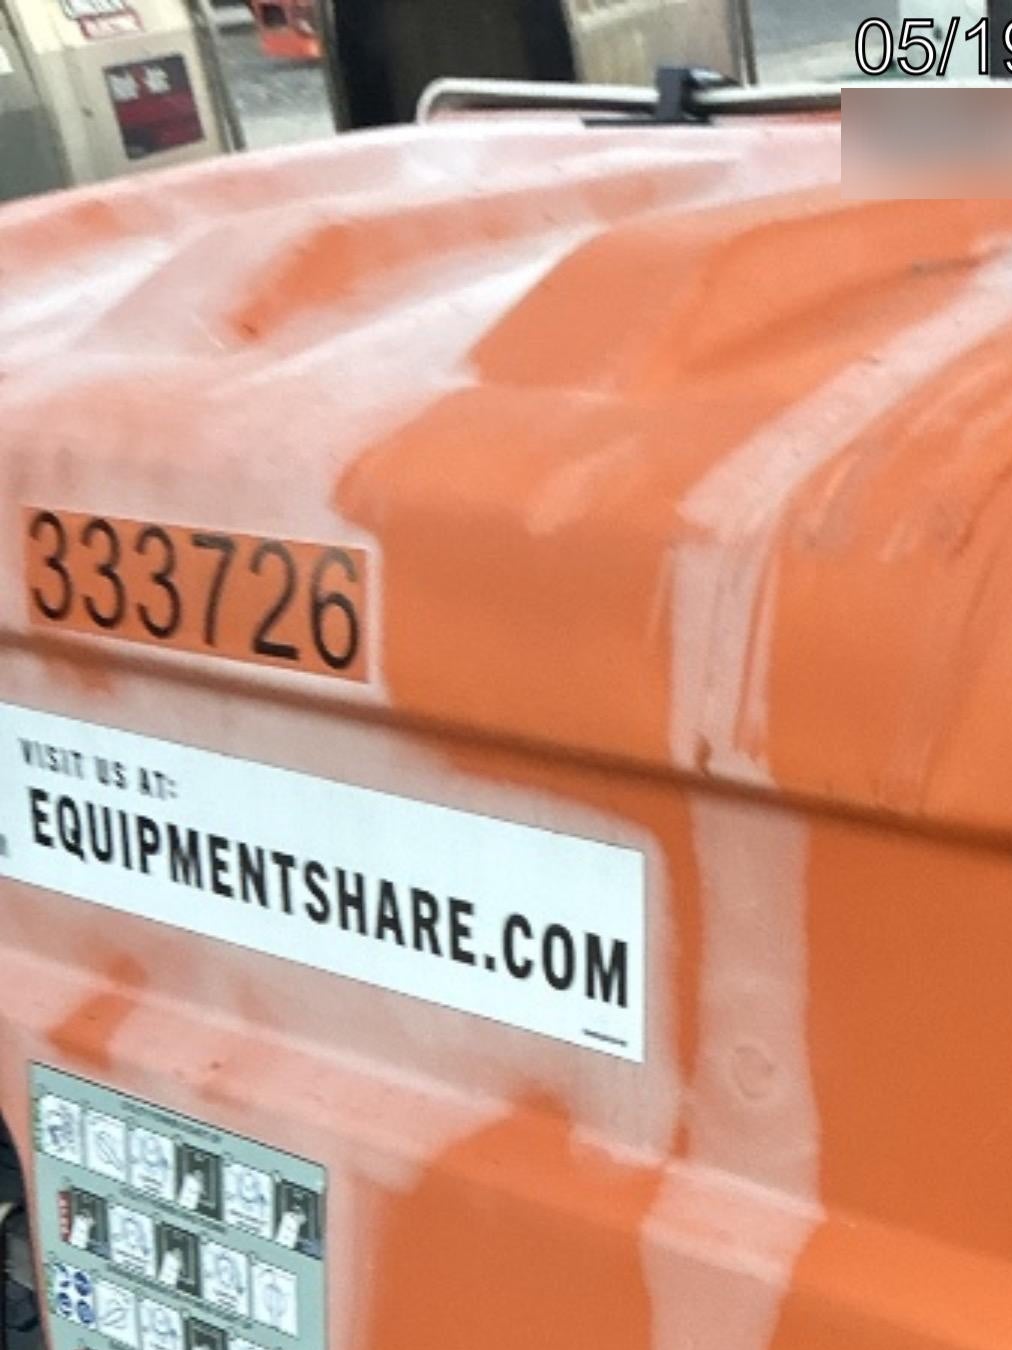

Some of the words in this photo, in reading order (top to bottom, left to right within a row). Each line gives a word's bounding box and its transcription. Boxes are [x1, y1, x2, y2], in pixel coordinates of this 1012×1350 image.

[29, 510, 361, 670] 333726
[18, 737, 84, 780] VISIT
[94, 756, 128, 790] US
[137, 766, 178, 800] AT:
[27, 786, 629, 1009] EQUIPMENTSHARE.COM
